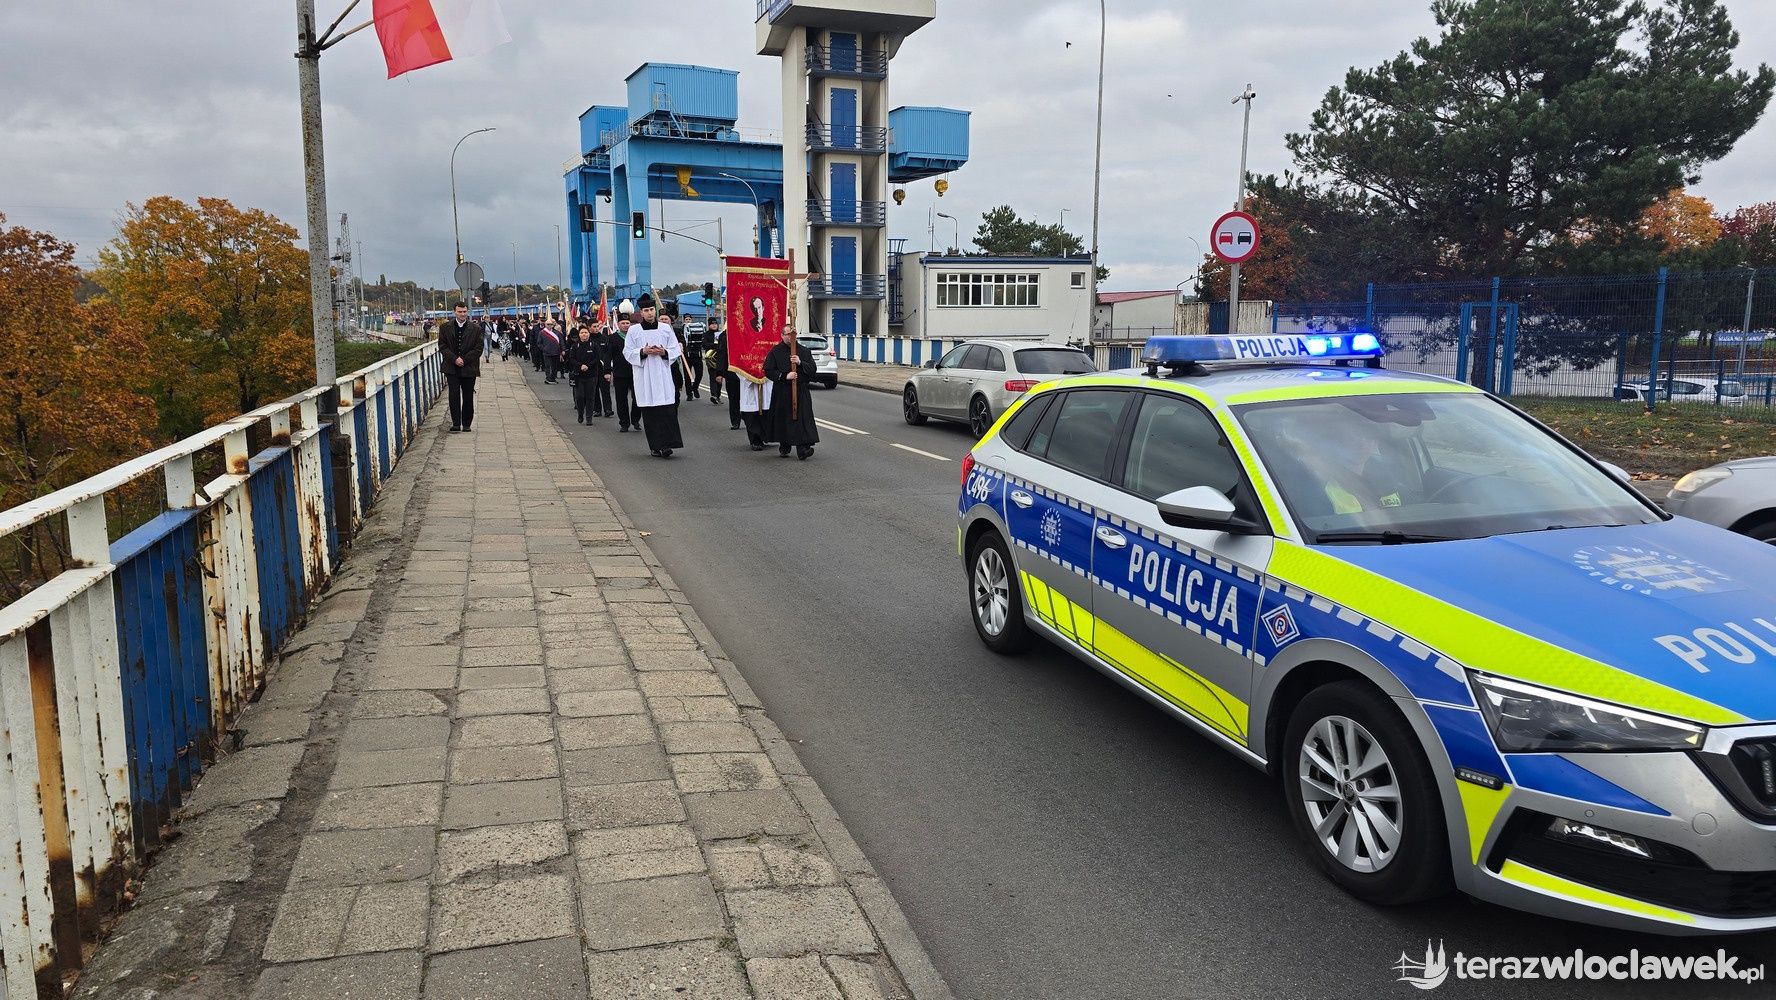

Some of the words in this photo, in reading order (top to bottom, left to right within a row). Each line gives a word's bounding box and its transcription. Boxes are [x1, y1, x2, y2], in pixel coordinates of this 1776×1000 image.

[1239, 337, 1310, 358] POLICJA
[966, 472, 991, 502] C496
[1128, 544, 1239, 634] POLICJA
